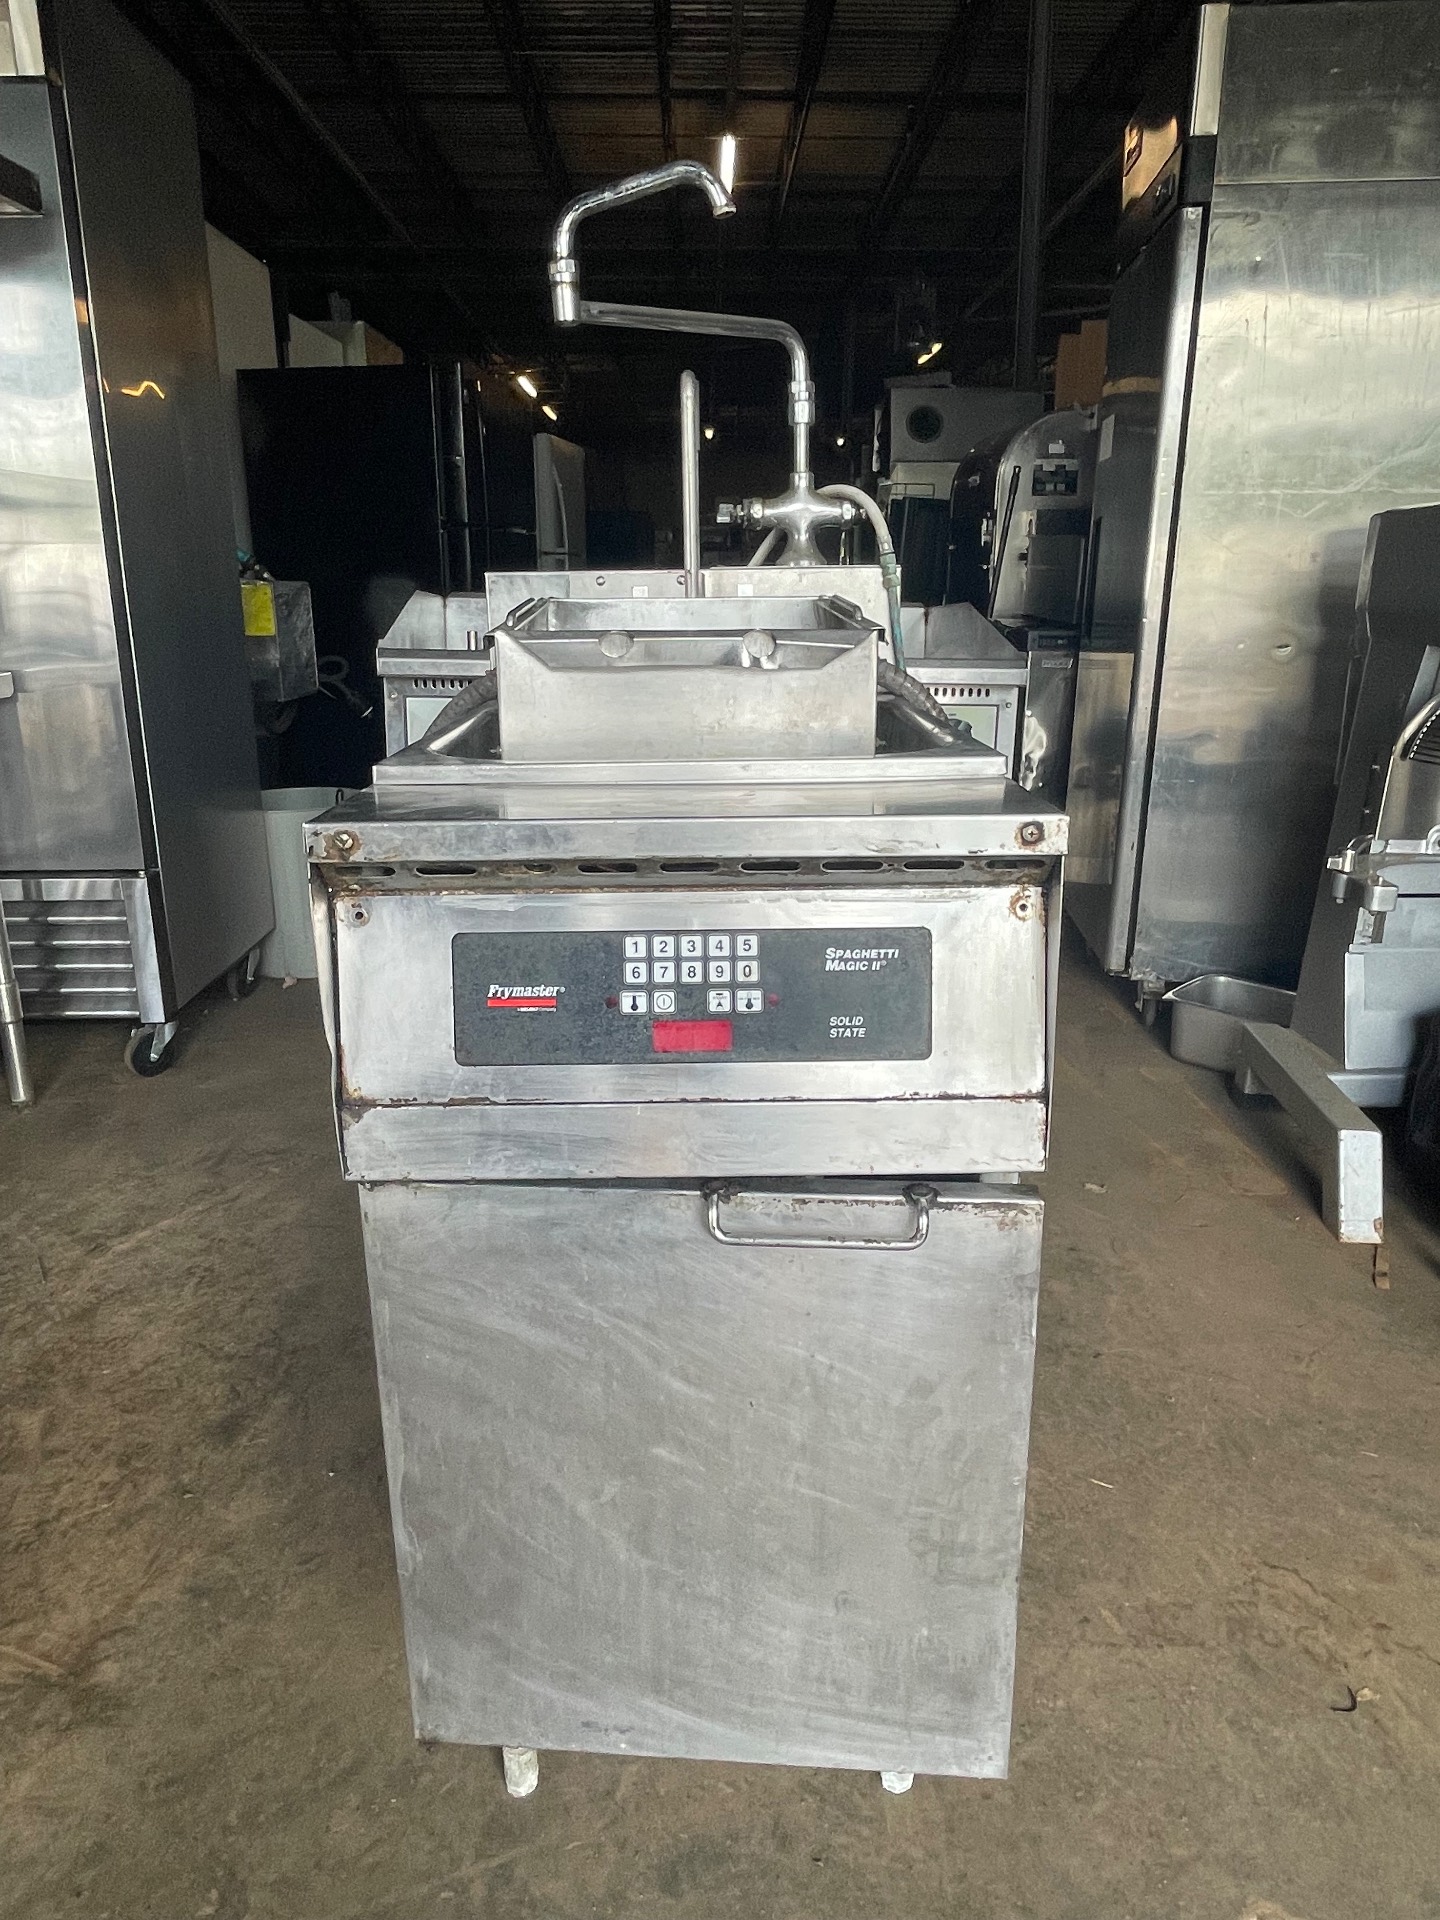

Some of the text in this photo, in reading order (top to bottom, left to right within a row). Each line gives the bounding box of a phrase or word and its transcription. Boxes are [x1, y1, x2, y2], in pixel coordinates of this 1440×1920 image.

[632, 939, 752, 953] 1 2 3 4 5
[825, 947, 899, 959] SPAGHETTI
[632, 964, 752, 979] 6 7 8 9 0
[825, 960, 868, 971] MAGIC
[487, 984, 559, 999] Frymaster
[829, 1016, 864, 1026] SOLID
[829, 1028, 866, 1038] STATE
